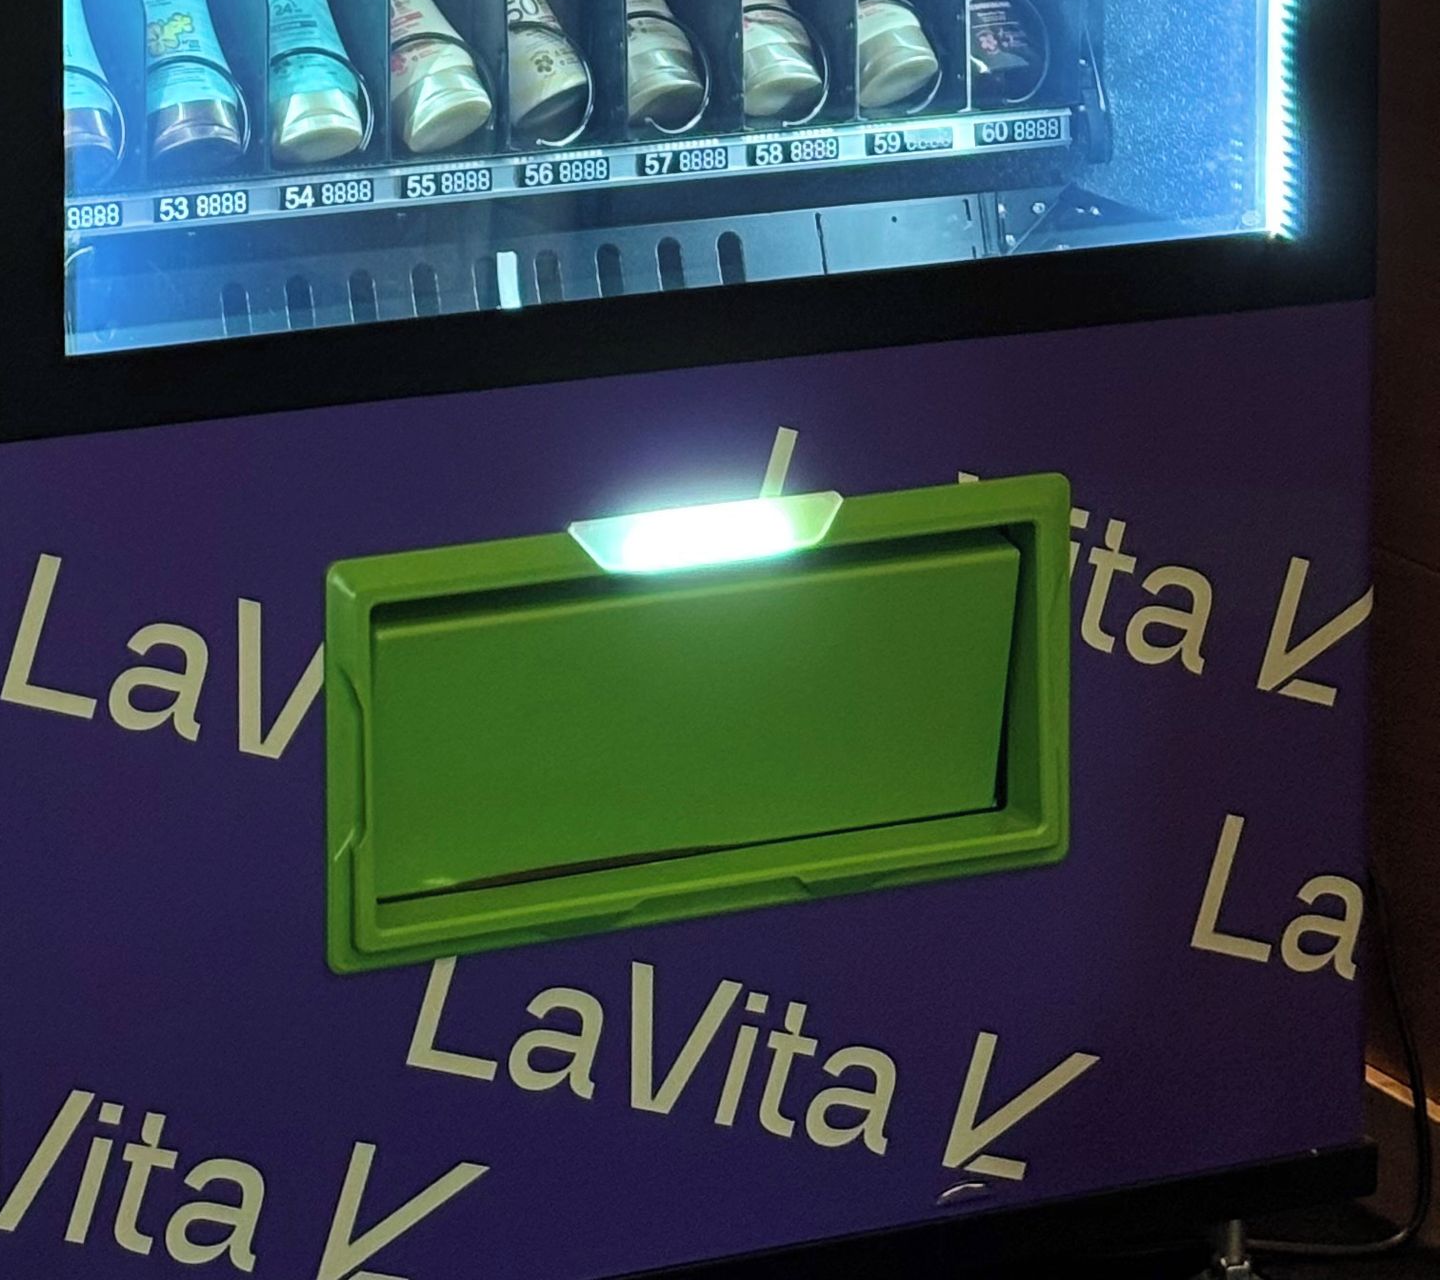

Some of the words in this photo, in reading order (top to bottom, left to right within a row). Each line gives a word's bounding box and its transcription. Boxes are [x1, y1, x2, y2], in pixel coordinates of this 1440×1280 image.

[273, 2, 293, 16] 24
[67, 203, 120, 229] 8888
[160, 196, 189, 222] 53
[196, 192, 247, 217] 8888
[285, 185, 315, 210] 54
[321, 180, 372, 205] 8888
[407, 174, 435, 198] 55
[441, 169, 490, 193] 8888
[524, 163, 553, 186] 56
[645, 151, 673, 175] 57
[679, 147, 726, 172] 8888
[755, 142, 783, 165] 58
[790, 138, 837, 162] 8888
[874, 132, 901, 154] 59
[982, 121, 1008, 144] 60
[1013, 118, 1059, 141] 8888
[405, 955, 900, 1156] LaVita
